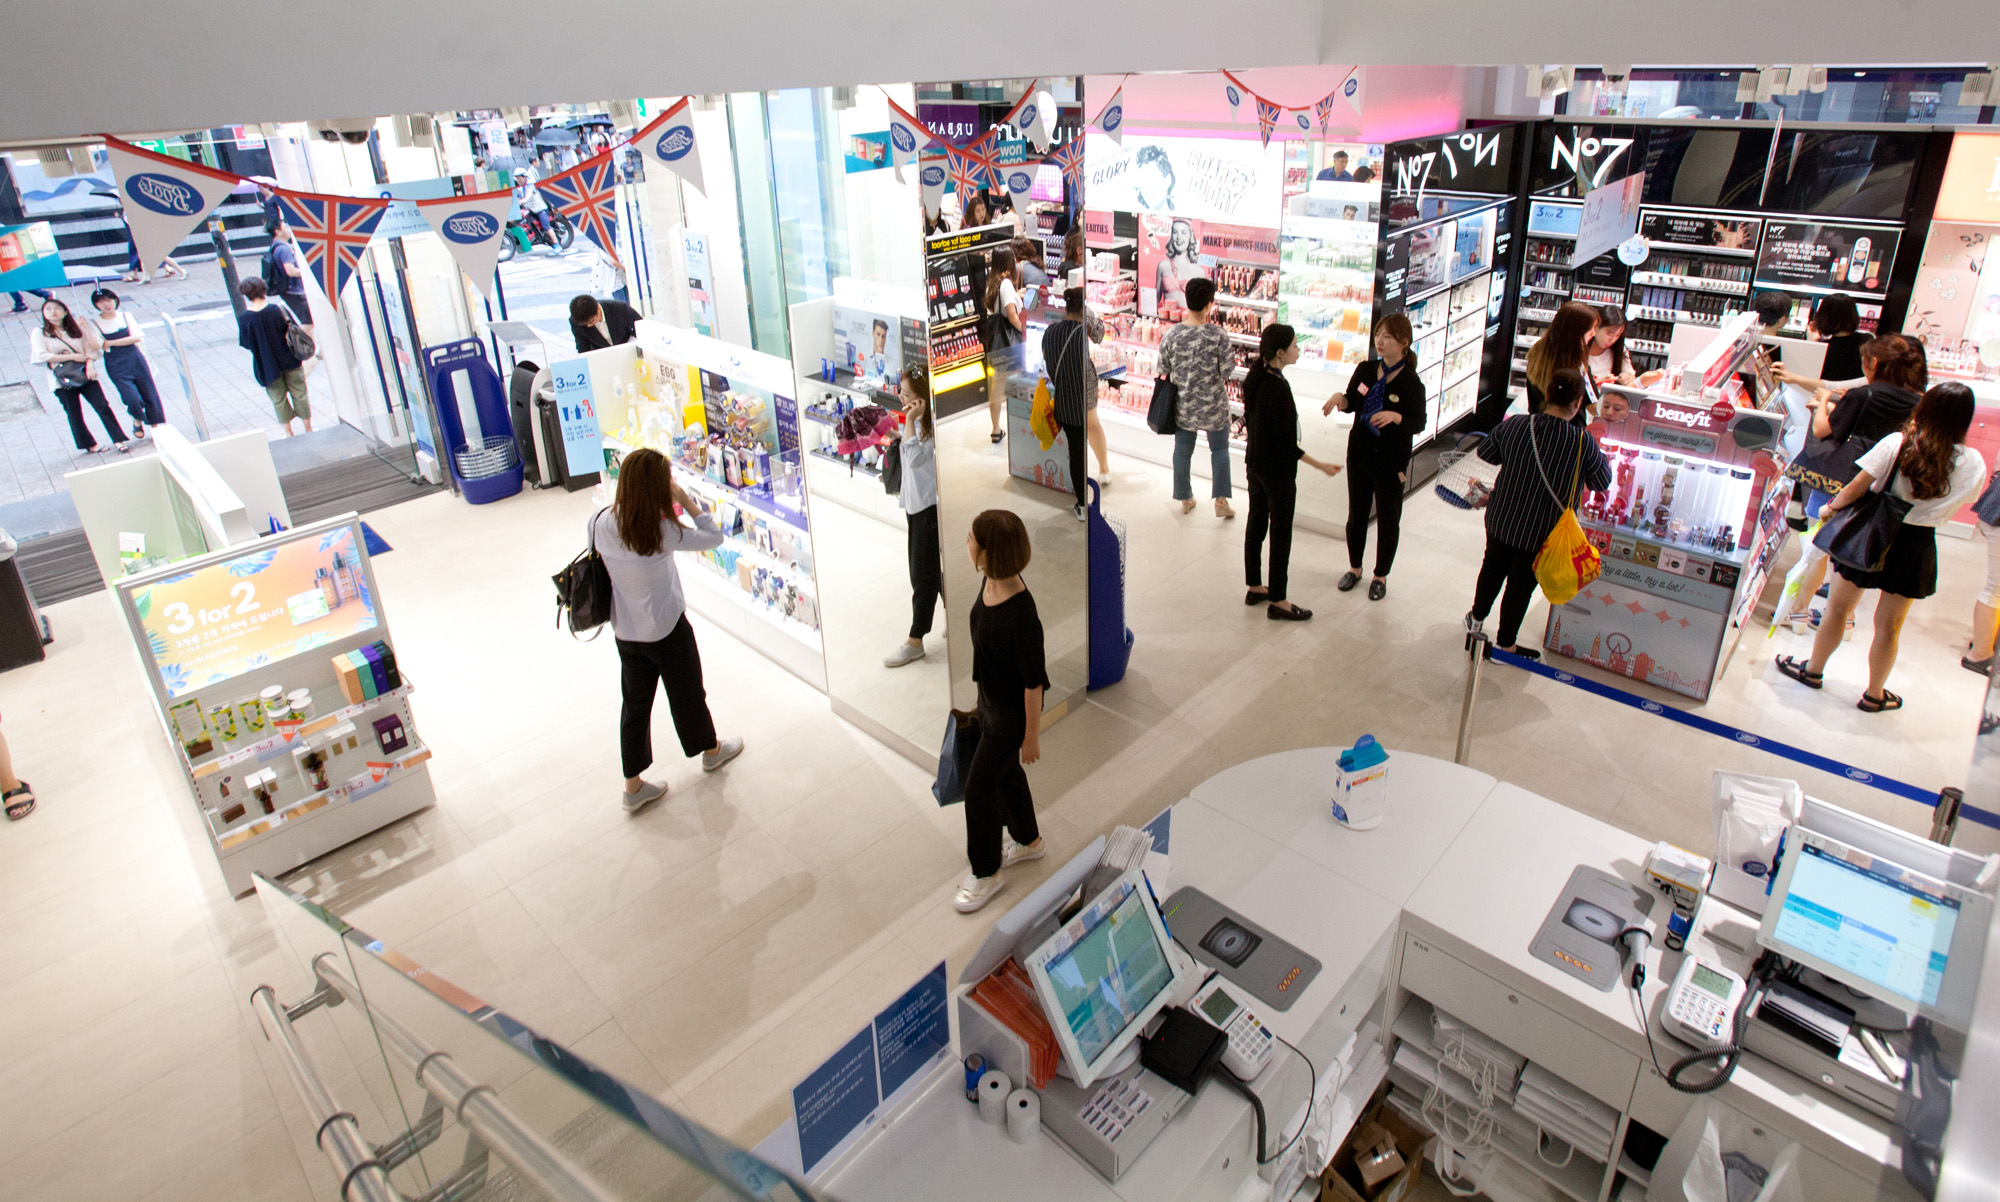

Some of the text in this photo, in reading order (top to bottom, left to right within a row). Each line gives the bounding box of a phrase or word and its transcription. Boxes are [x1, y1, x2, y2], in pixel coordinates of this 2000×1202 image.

[1092, 157, 1131, 186] GLORY
[1536, 206, 1564, 219] 3 for 2
[685, 238, 691, 252] 3
[697, 240, 704, 254] 2
[1203, 236, 1277, 254] MAKE UP MUST-HAVES
[1623, 245, 1630, 254] 3
[1637, 247, 1643, 255] 2
[659, 364, 676, 380] EGG
[555, 377, 565, 389] 3
[577, 373, 586, 386] 2
[1654, 403, 1712, 428] benefit
[1652, 431, 1678, 444] gimme
[1622, 568, 1642, 583] little,
[1644, 576, 1659, 589] try
[1658, 580, 1665, 588] a
[1665, 580, 1686, 593] lot!
[163, 581, 261, 635] 3 for 2
[202, 628, 218, 640] 2개
[250, 606, 285, 625] 드립니다
[255, 744, 262, 752] 3
[267, 740, 274, 748] 2
